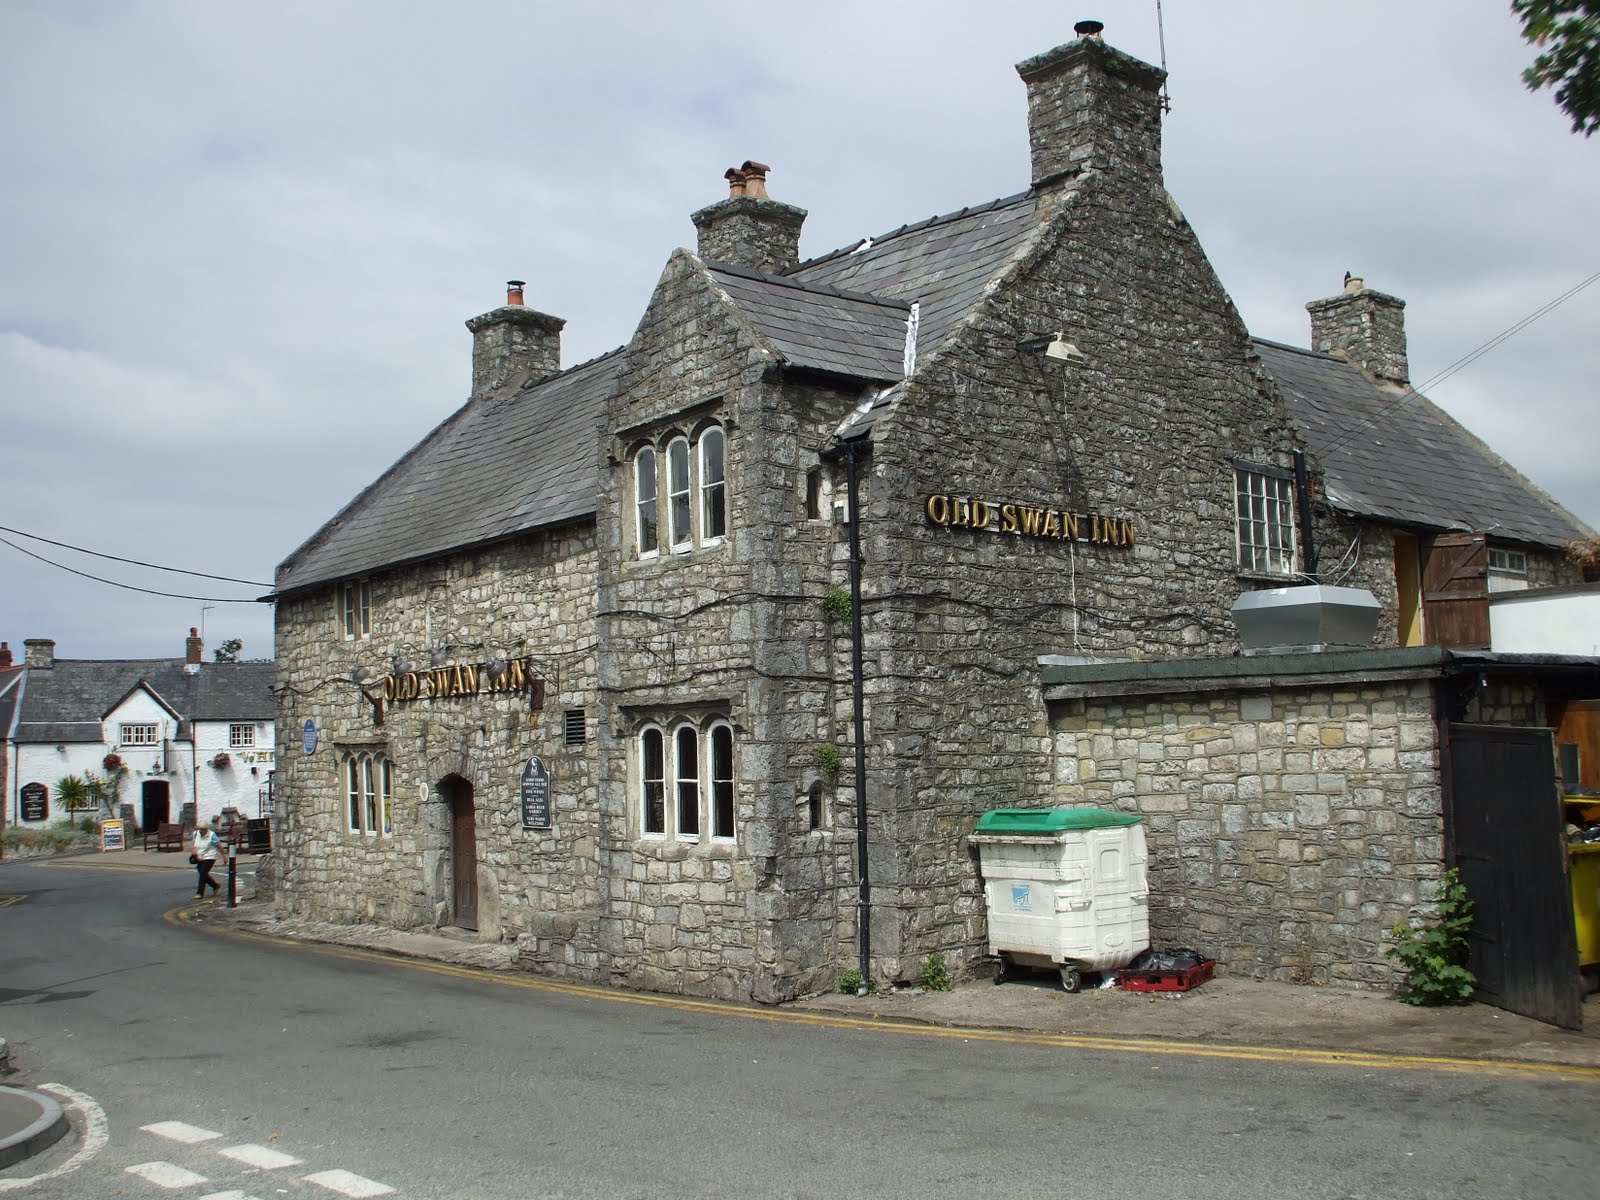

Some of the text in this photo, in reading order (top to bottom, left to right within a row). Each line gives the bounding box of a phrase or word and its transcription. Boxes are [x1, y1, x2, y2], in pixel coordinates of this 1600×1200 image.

[927, 494, 1135, 546] OLD SWAN INN
[384, 672, 418, 700] OLD
[426, 664, 479, 698] SWAN
